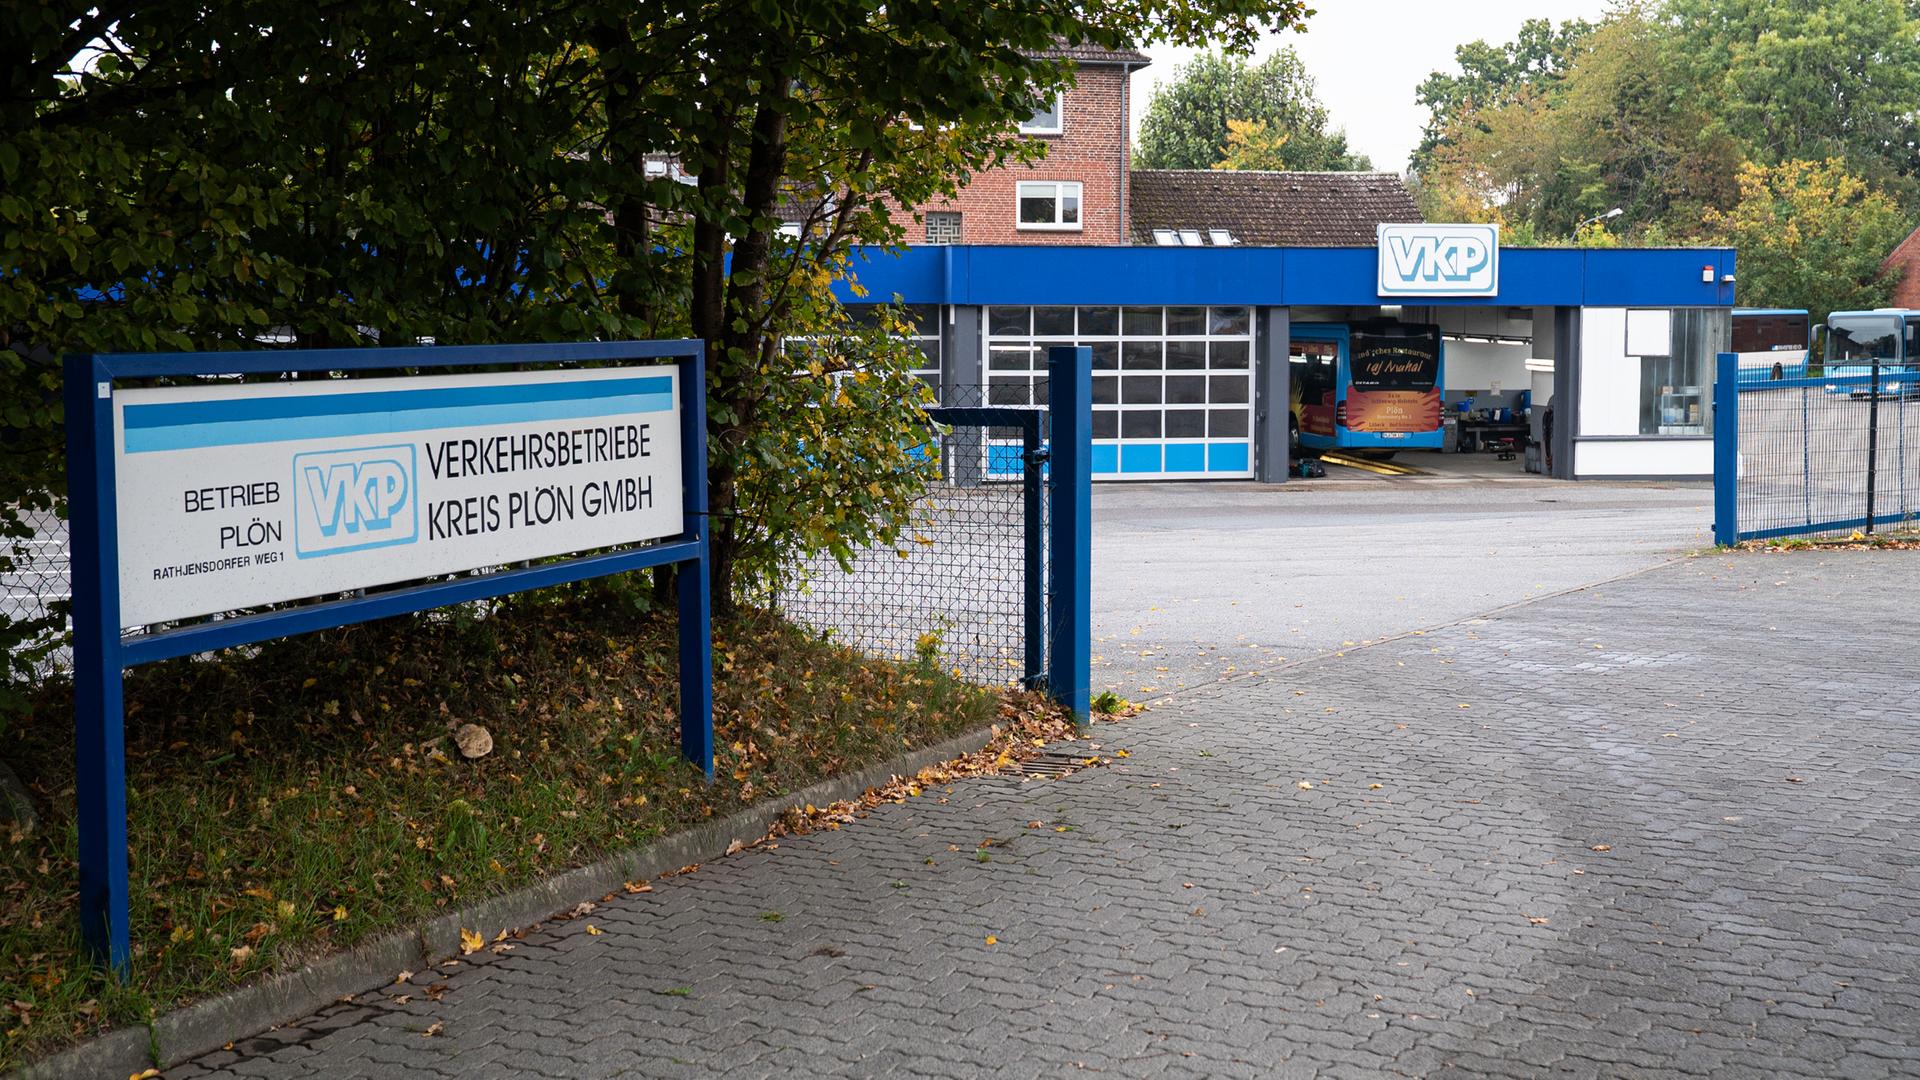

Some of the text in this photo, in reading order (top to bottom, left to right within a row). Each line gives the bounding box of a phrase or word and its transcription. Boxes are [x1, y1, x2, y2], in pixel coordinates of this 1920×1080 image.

[1388, 236, 1488, 281] VKP
[425, 423, 651, 480] VERKEHRSBETRIEBE
[184, 481, 280, 513] BETRIEB
[304, 459, 408, 537] VKP
[428, 475, 653, 541] KREIS PLÖN GMBH
[220, 517, 282, 550] PLÖN
[153, 555, 251, 581] RATHJENSDORFER
